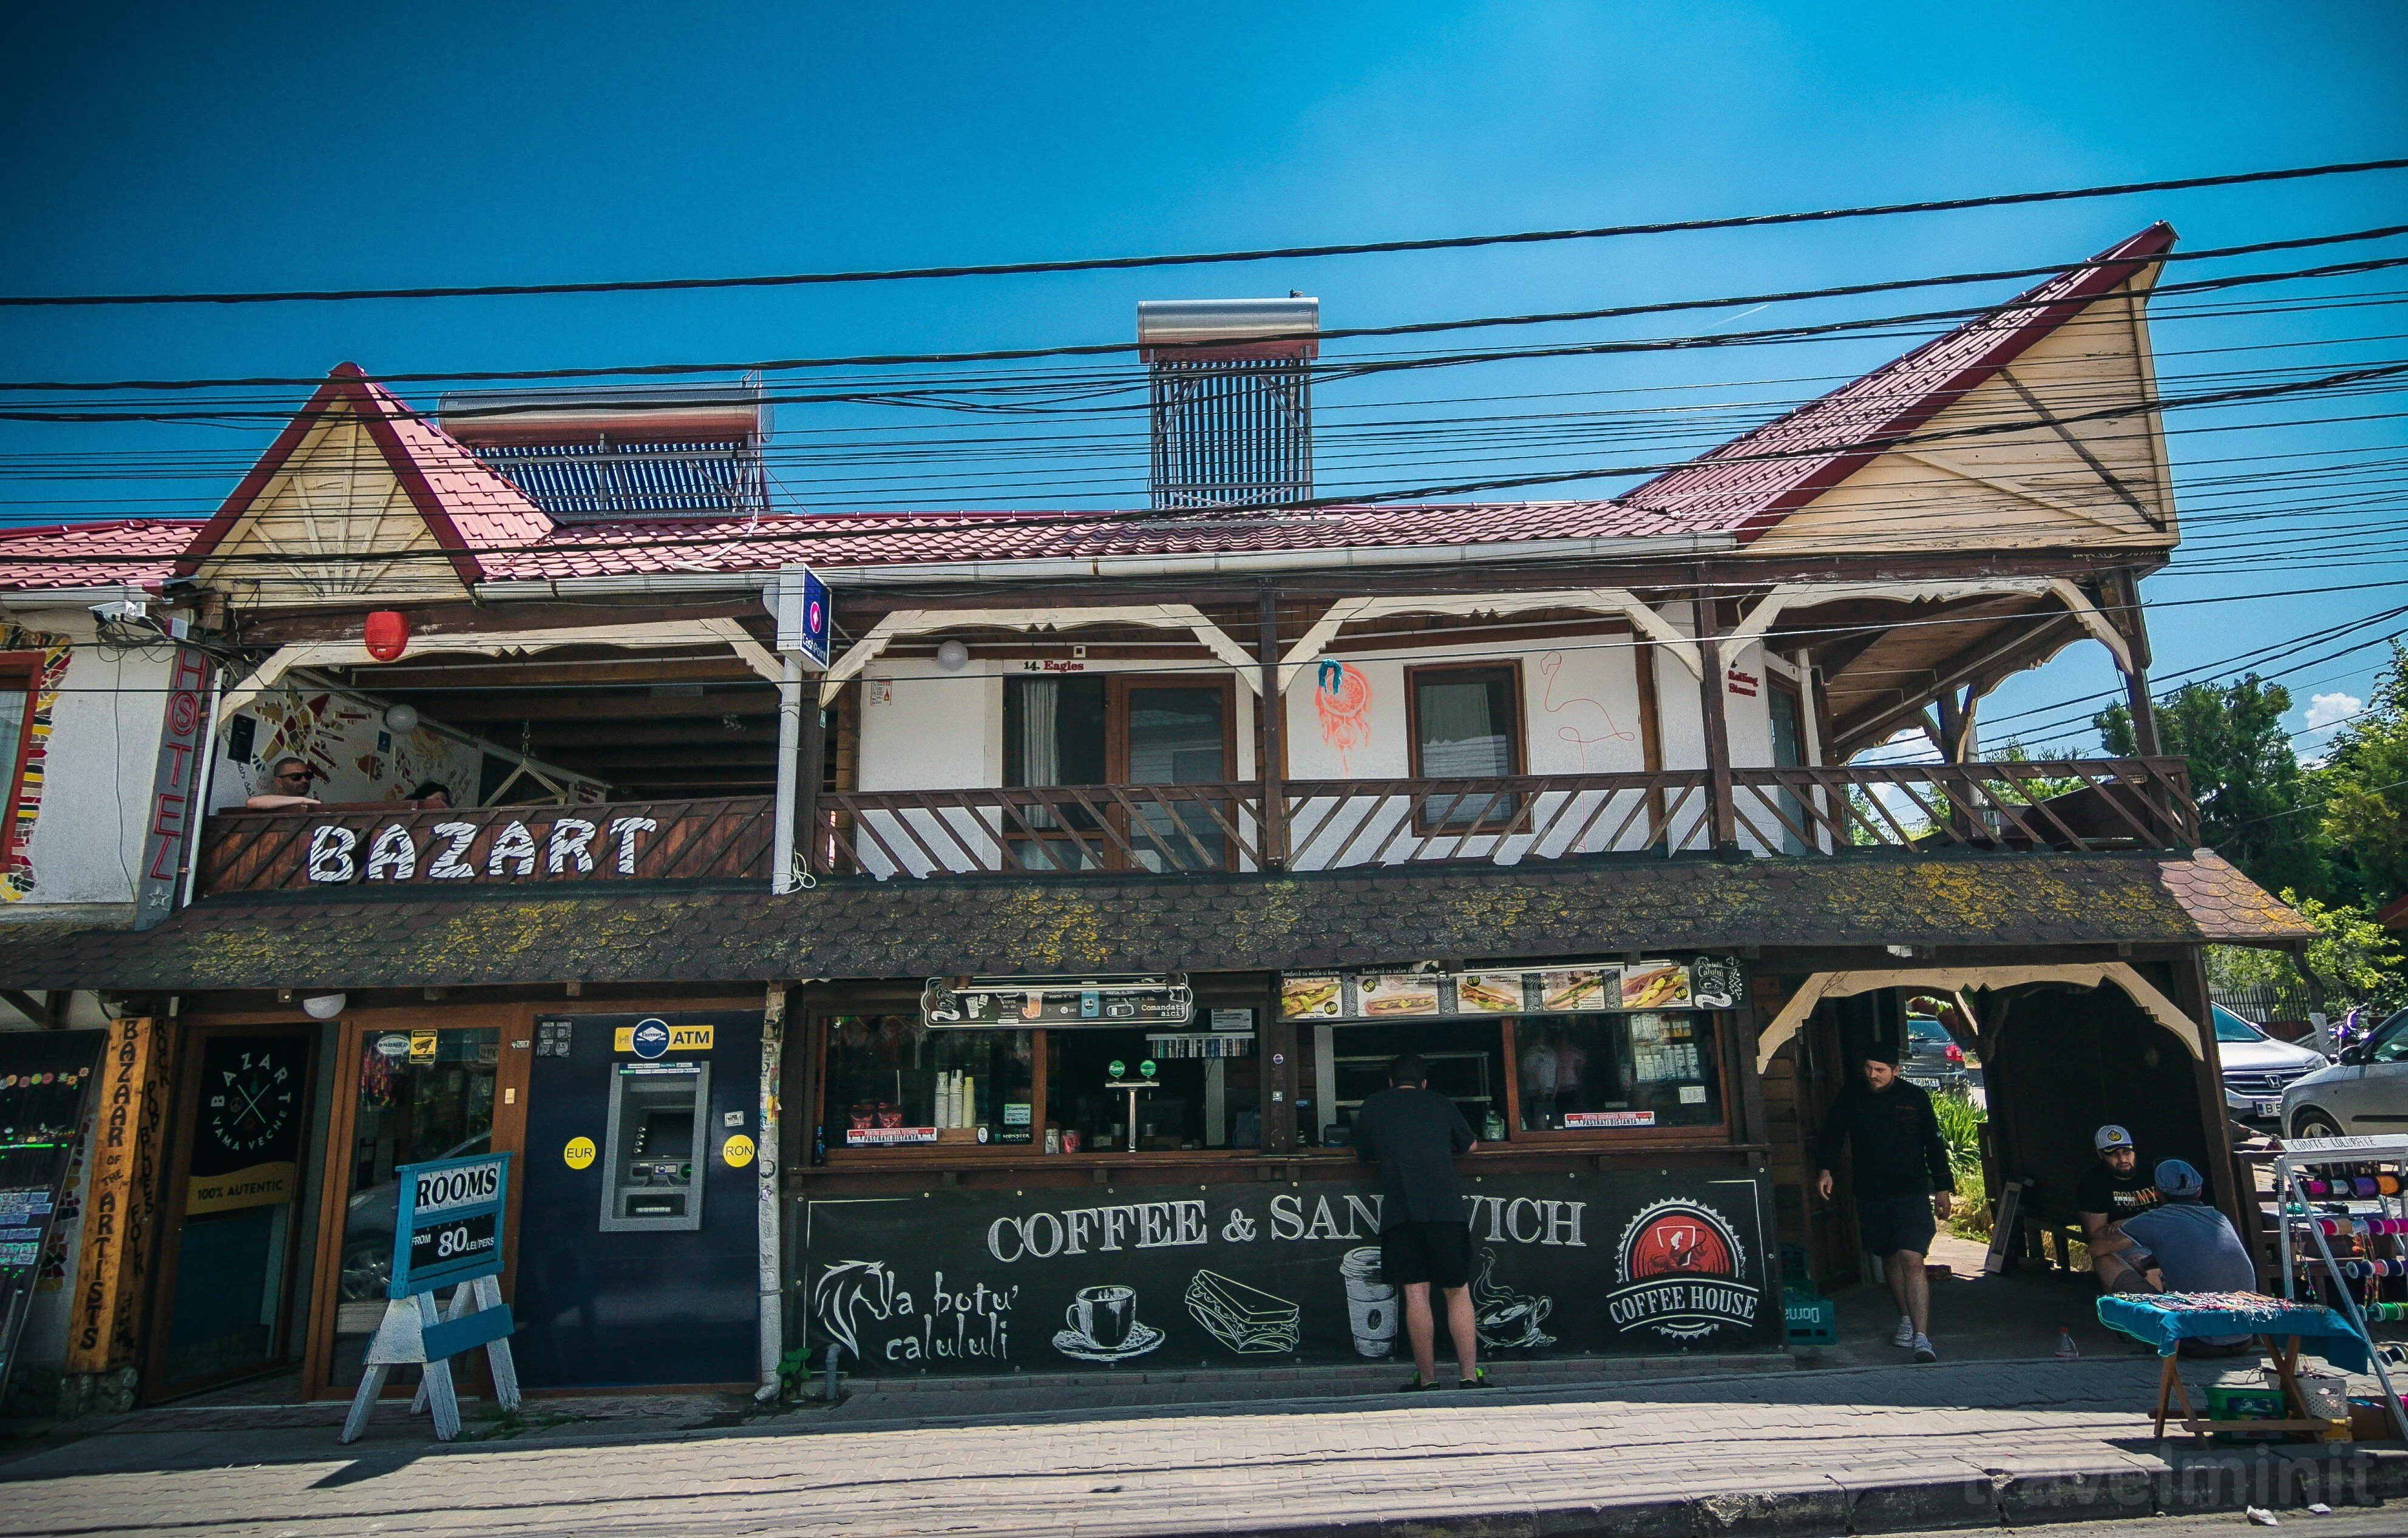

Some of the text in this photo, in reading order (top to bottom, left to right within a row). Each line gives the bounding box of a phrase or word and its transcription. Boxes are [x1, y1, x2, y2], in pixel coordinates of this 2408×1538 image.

[802, 632, 826, 662] CashPoint
[1023, 660, 1084, 672] 14. Eagles
[1728, 669, 1759, 687] Rolling
[309, 818, 657, 882] BAZART
[673, 1031, 710, 1045] ATM
[108, 1020, 139, 1148] BAZAAR
[210, 1052, 292, 1108] BAZART
[147, 1080, 160, 1134] POP
[2265, 1103, 2273, 1114] B
[212, 1109, 288, 1151] VAMA VECHE
[106, 1154, 121, 1166] OF
[566, 1148, 593, 1159] EUR
[725, 1145, 754, 1157] RON
[101, 1170, 124, 1188] THE
[197, 1179, 284, 1201] 100% AUTENTIC
[416, 1167, 498, 1208] ROOMS
[2112, 1186, 2158, 1207] TOMMY
[412, 1234, 432, 1247] FROM
[438, 1226, 467, 1256] 80
[987, 1194, 1587, 1262] COFFEE & SANICH
[80, 1191, 115, 1350] ARTISTS
[887, 1271, 914, 1316] la
[1609, 1285, 1758, 1324] COFFEE HOUSE
